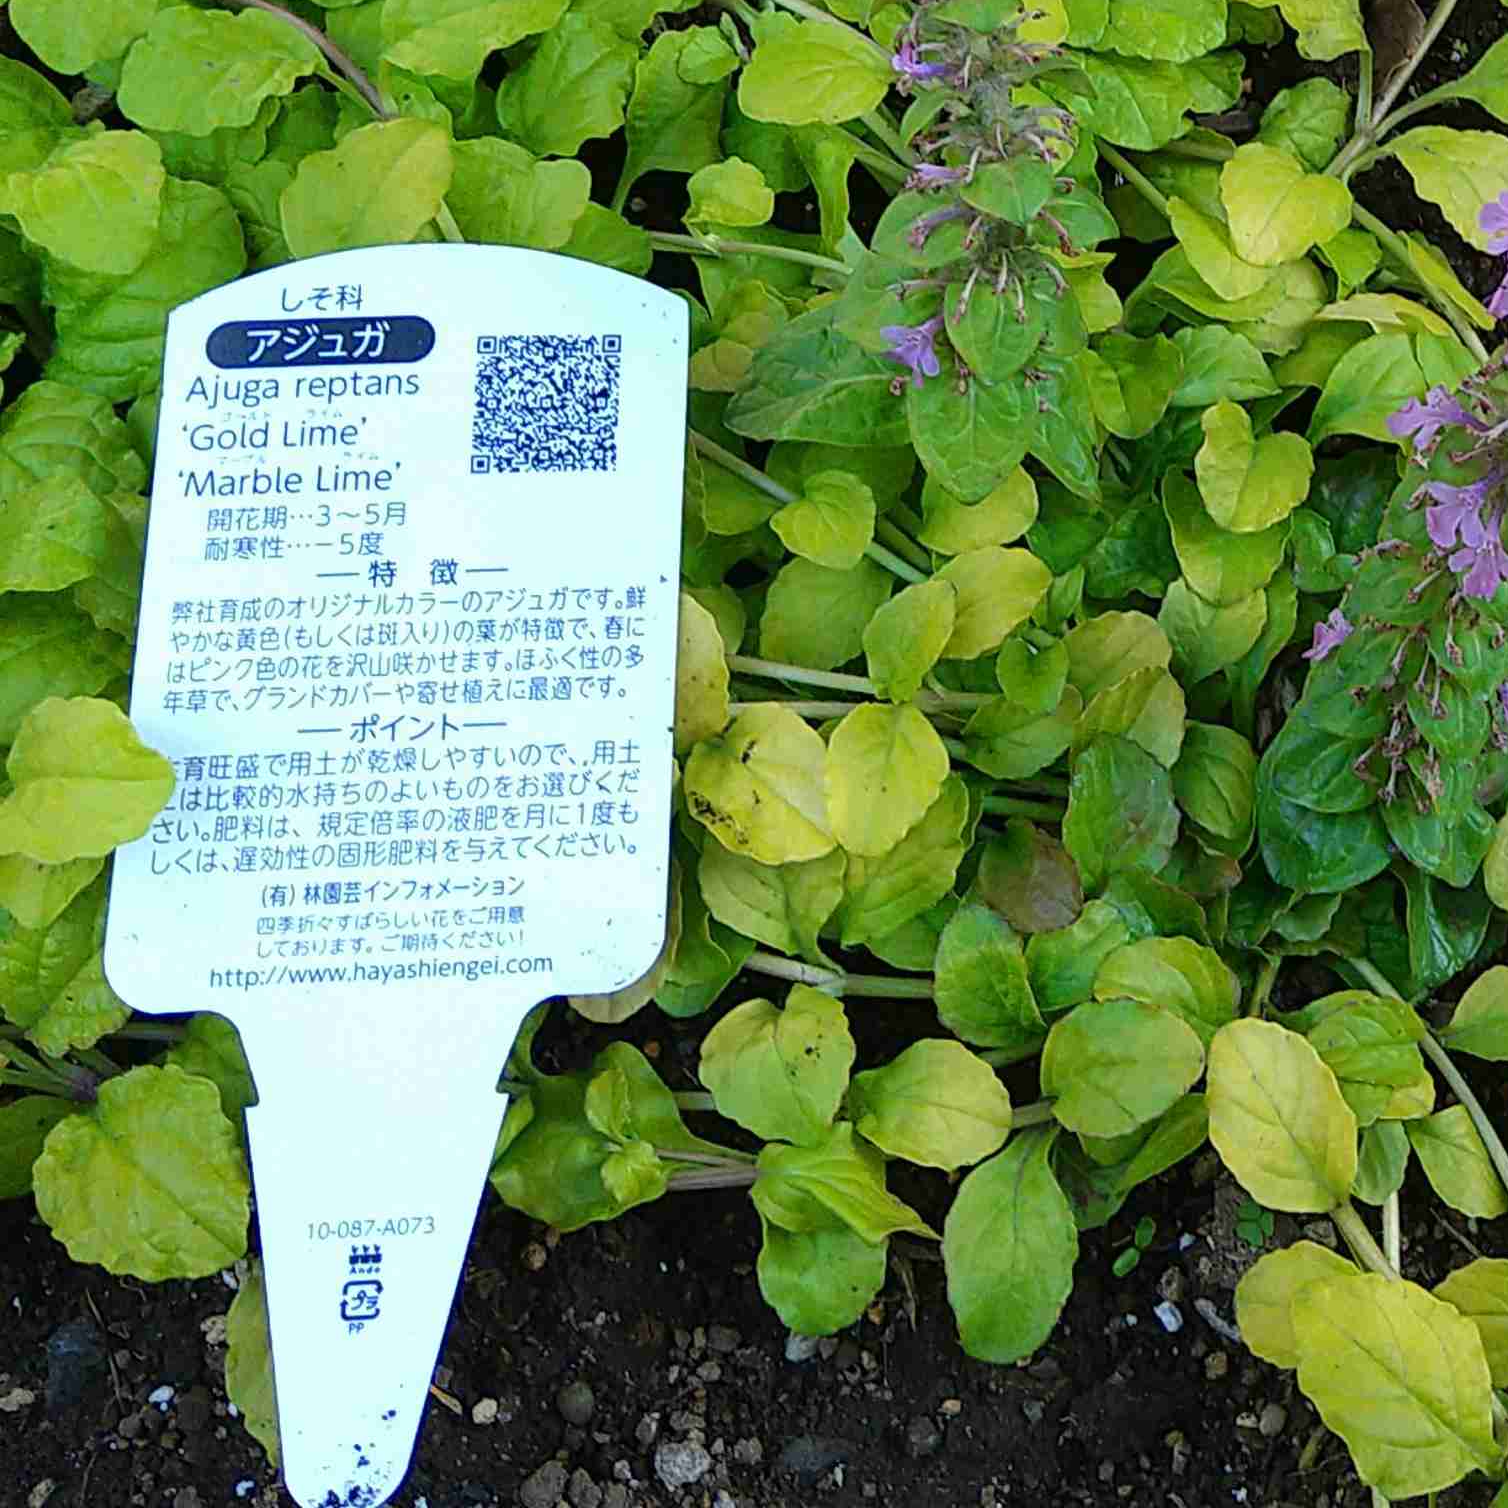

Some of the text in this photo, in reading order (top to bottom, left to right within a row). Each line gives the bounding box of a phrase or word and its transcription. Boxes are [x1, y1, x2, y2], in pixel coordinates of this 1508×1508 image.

[281, 284, 364, 312] しそ科
[245, 320, 391, 362] アジュガ
[185, 371, 420, 410] Ajuga reptans
[350, 713, 460, 743] ポイント
[164, 769, 640, 812] は比較的水持ちのよいものをお選びくだ
[210, 956, 553, 992] http://www.hayashiengei.com
[306, 1215, 436, 1240] 10-087-A073
